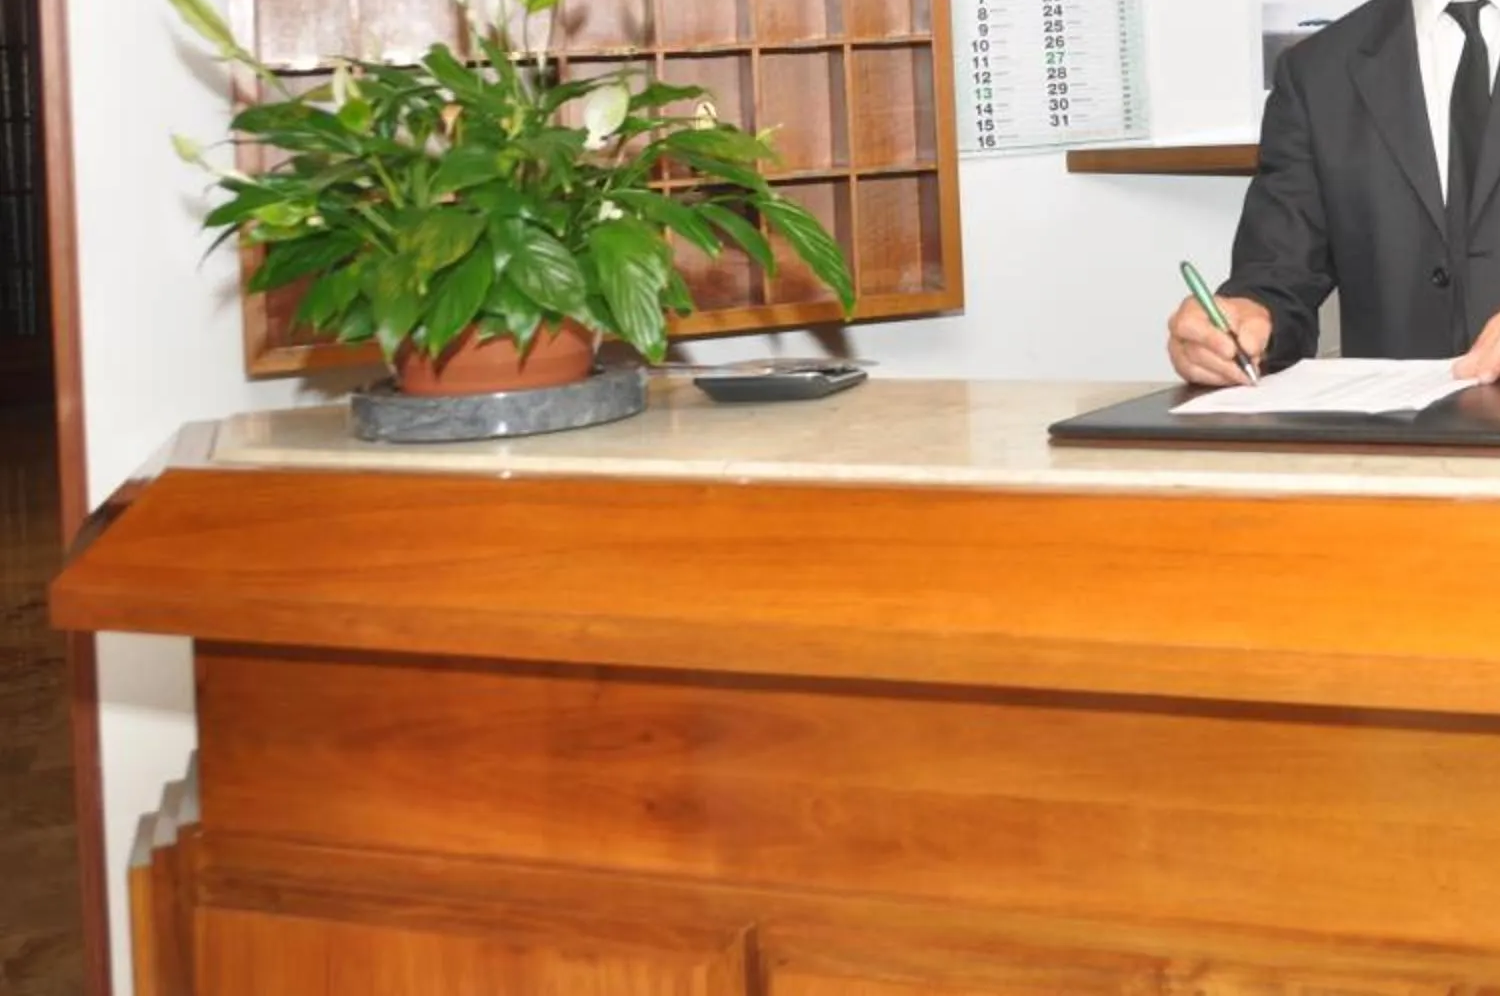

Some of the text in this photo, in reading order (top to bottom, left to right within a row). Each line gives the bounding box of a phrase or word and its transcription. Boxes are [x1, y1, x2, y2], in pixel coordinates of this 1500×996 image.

[978, 7, 988, 21] 8
[1043, 5, 1063, 17] 24
[978, 24, 989, 36] 9
[1044, 20, 1064, 33] 25
[972, 39, 989, 52] 10
[1045, 35, 1065, 49] 26
[973, 56, 989, 68] 11
[1046, 51, 1065, 64] 27
[973, 71, 992, 84] 12
[1047, 67, 1067, 80] 28
[975, 87, 993, 100] 13
[1047, 82, 1068, 95] 29
[976, 103, 993, 115] 14
[1049, 98, 1069, 111] 30
[976, 119, 995, 132] 15
[1050, 113, 1069, 127] 31
[978, 134, 996, 147] 16
